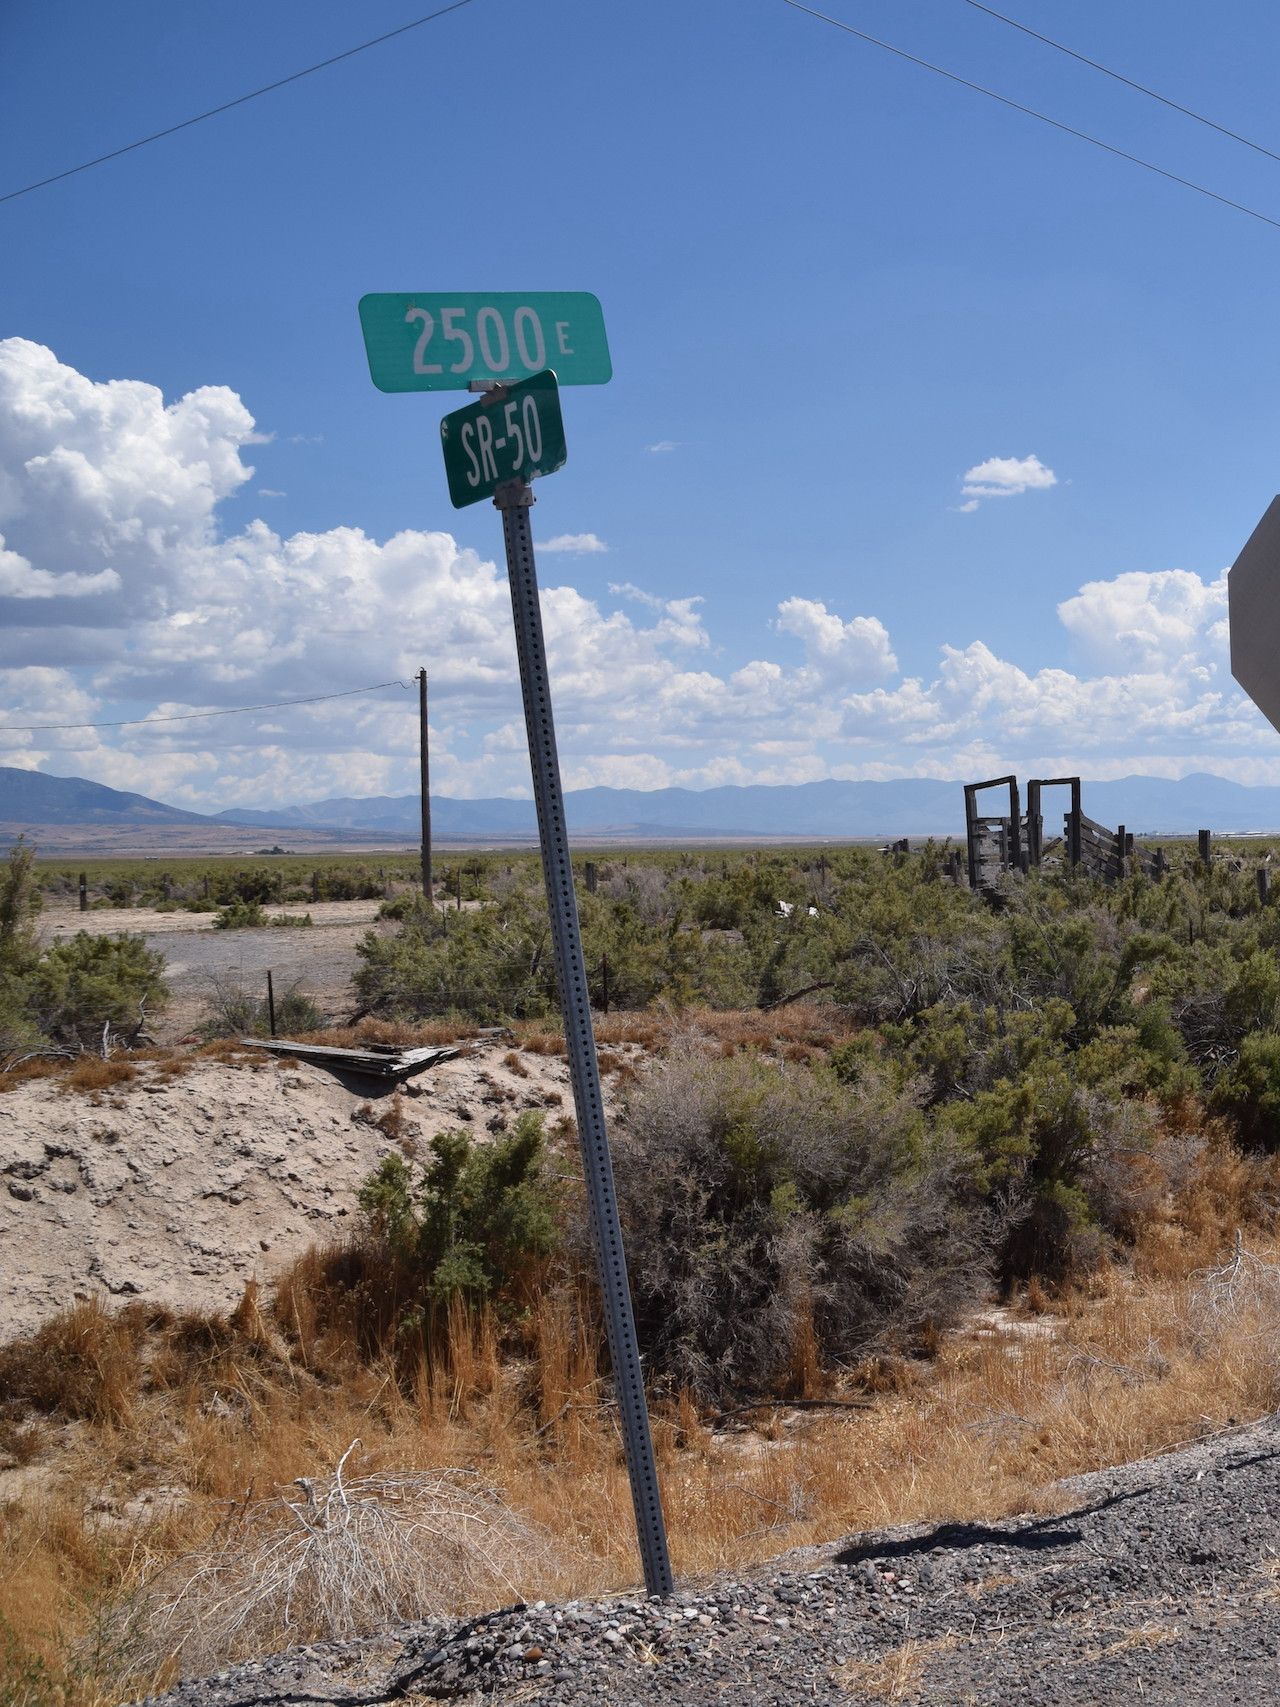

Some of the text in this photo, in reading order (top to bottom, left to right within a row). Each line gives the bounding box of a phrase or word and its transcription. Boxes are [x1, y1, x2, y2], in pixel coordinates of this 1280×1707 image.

[405, 306, 574, 374] 2500 E
[461, 395, 543, 487] SR-50
